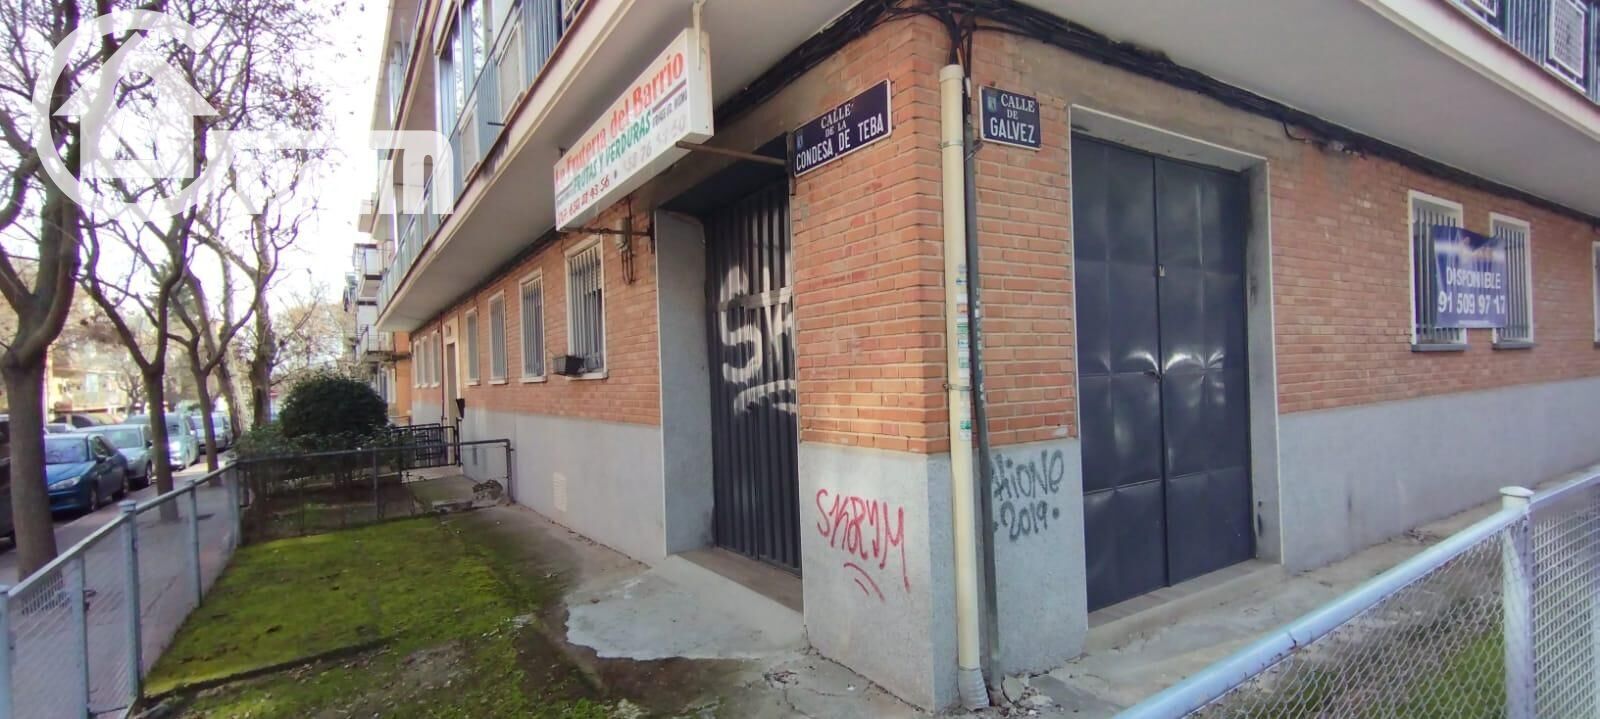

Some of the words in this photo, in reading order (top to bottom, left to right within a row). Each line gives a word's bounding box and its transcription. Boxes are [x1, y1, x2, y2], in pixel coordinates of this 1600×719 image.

[611, 98, 629, 139] del
[633, 53, 684, 116] Barrio
[1001, 93, 1036, 113] CALLE
[821, 104, 852, 129] CALLE
[1007, 109, 1019, 120] DE
[796, 138, 834, 171] CONDESA
[839, 129, 851, 152] DE
[857, 112, 884, 142] TEBA
[825, 126, 835, 138] DE
[838, 120, 847, 131] LA
[990, 117, 1036, 144] GALVEZ
[573, 162, 597, 194] FRUTAS
[598, 151, 605, 174] Y
[605, 109, 651, 167] VERDURAS
[1446, 266, 1501, 290] DISPONIBLE
[1438, 290, 1453, 314] 91
[1456, 292, 1476, 315] 509
[1478, 294, 1491, 315] 97
